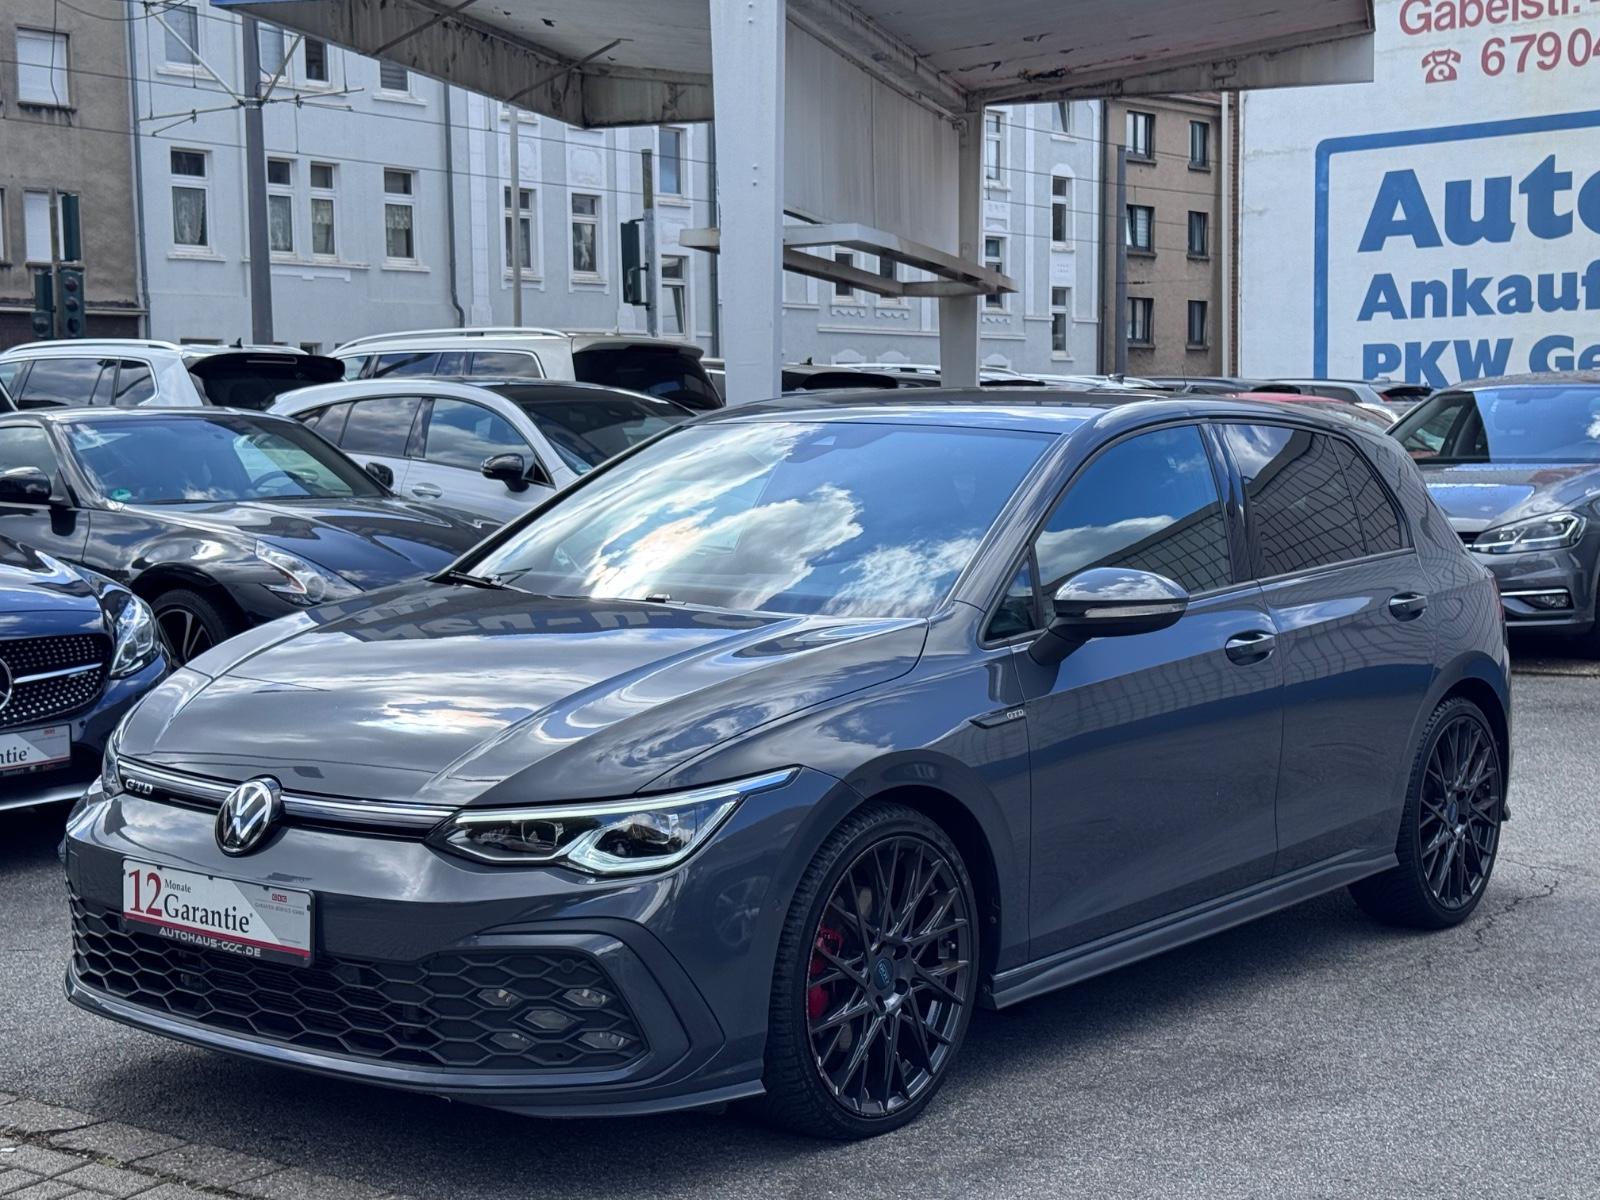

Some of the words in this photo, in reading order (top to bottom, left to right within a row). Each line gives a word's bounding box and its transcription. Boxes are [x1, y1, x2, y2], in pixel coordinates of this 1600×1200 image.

[1356, 258, 1600, 321] Ankauf
[1363, 337, 1513, 389] PKW
[1006, 708, 1024, 719] GTD
[125, 779, 154, 794] GTD
[128, 869, 163, 917] 12
[164, 878, 192, 894] Monate
[163, 893, 250, 934] Garantie
